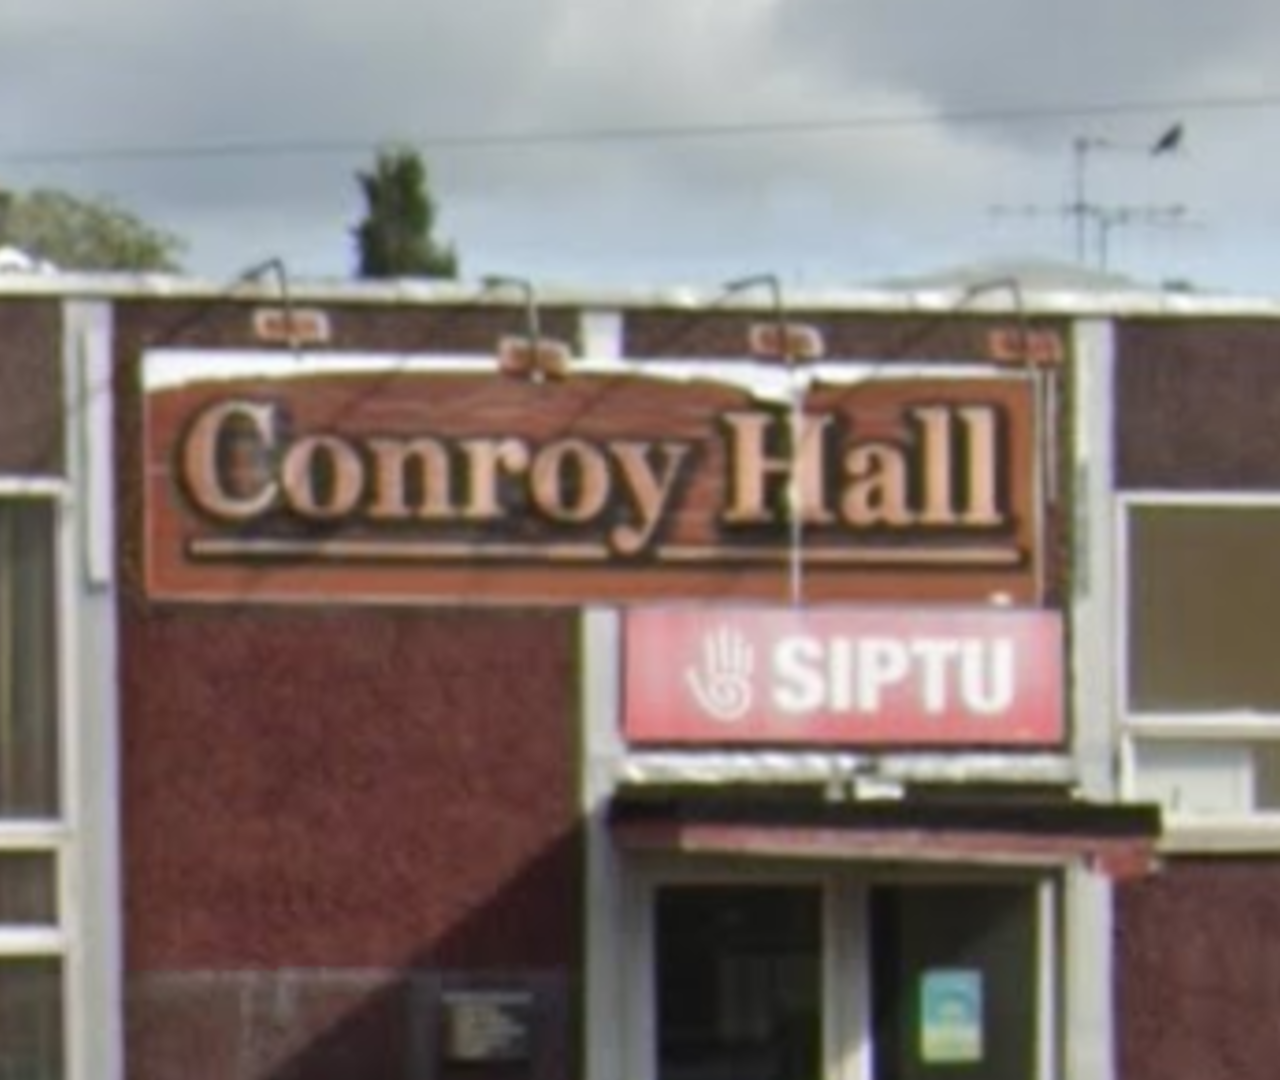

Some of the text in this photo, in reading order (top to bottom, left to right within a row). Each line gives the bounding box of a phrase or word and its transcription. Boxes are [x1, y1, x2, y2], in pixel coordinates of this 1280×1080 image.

[182, 400, 1004, 554] Conroy Hall
[771, 635, 1014, 716] SIPTU
